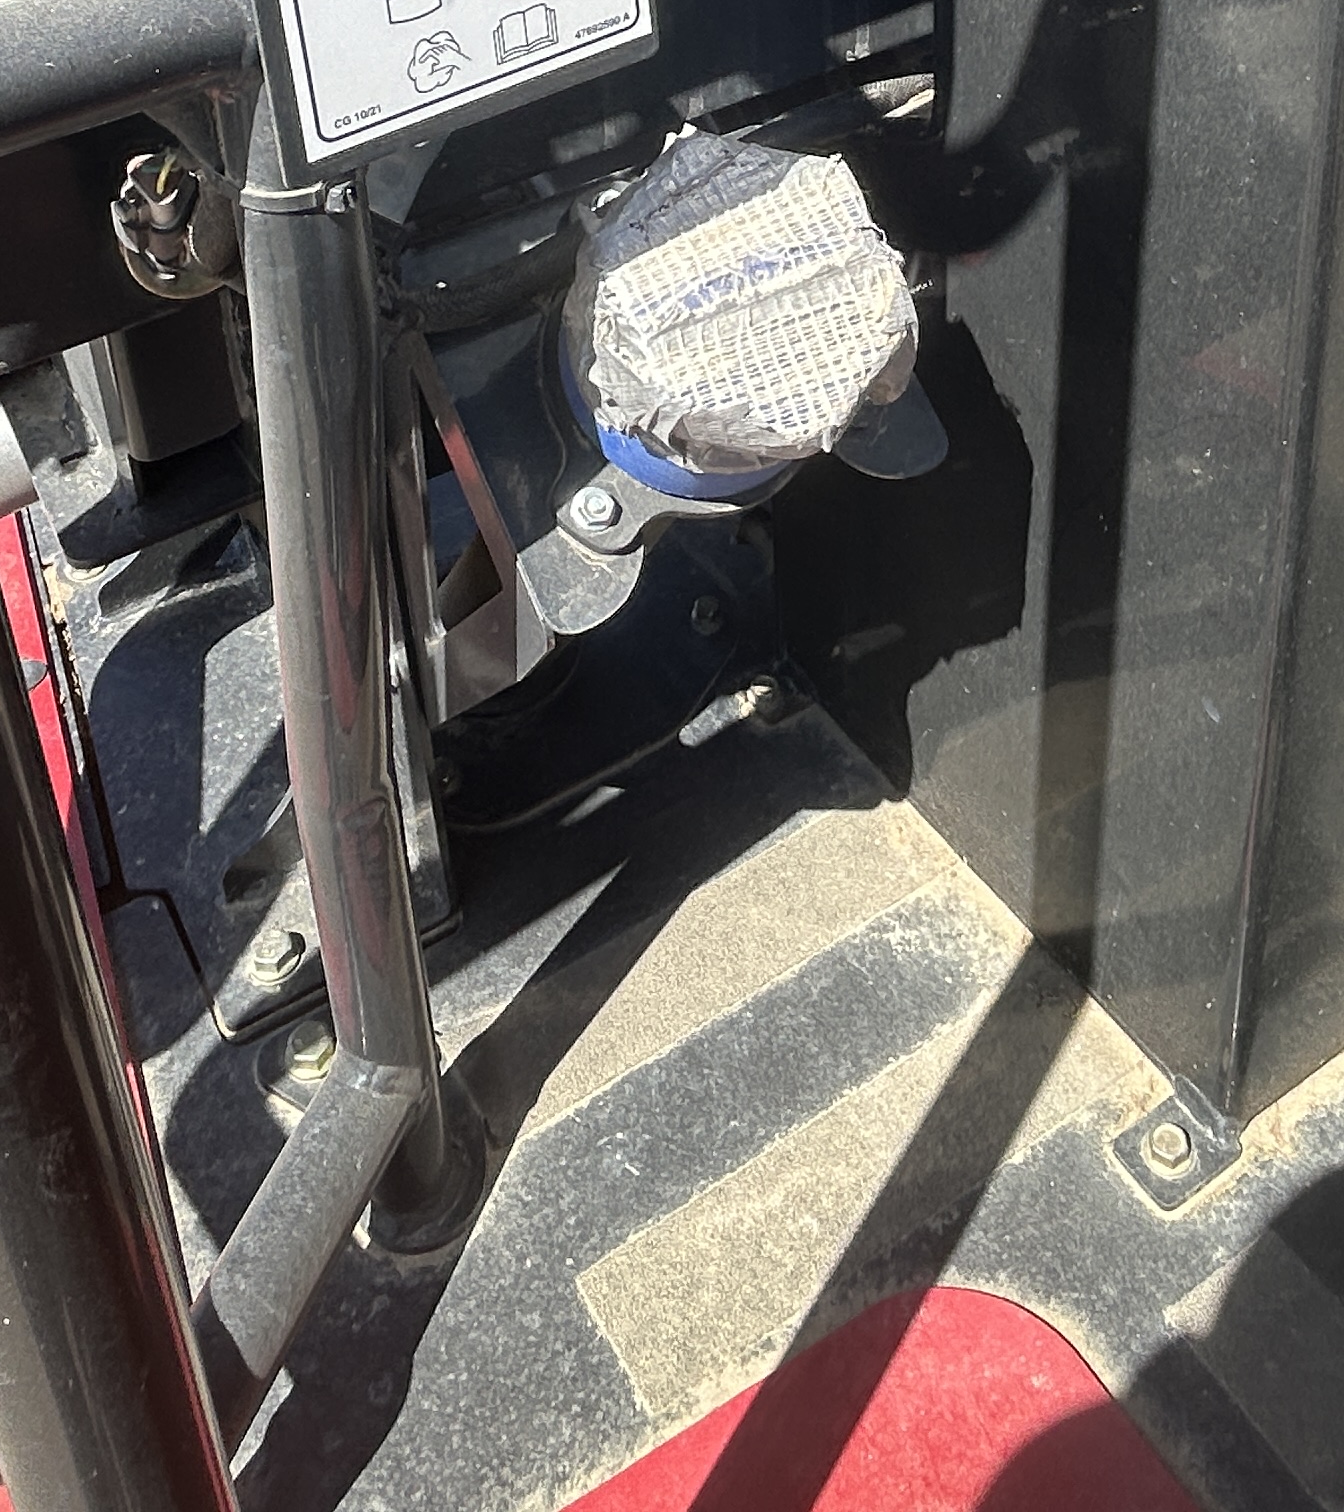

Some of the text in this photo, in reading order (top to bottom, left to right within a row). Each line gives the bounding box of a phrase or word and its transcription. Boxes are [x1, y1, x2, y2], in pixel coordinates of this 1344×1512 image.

[623, 11, 630, 22] A
[334, 103, 382, 129] CG 10/21
